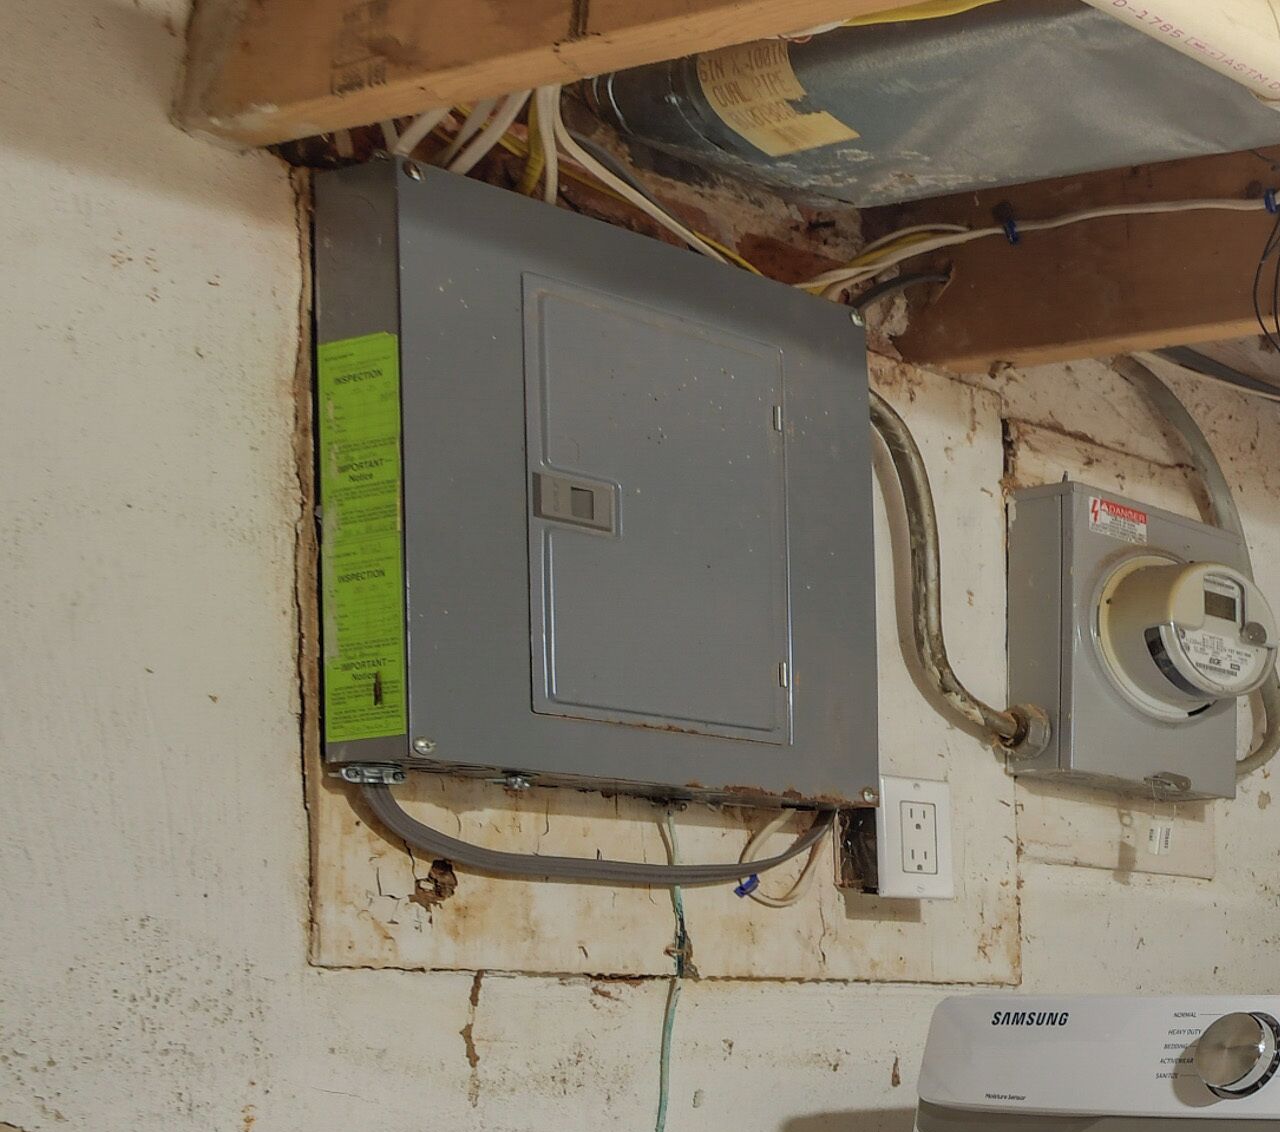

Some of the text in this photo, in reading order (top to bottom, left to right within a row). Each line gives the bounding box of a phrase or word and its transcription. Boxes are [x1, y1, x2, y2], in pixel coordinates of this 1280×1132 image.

[334, 368, 383, 385] INSPECTION
[1109, 503, 1147, 524] DANGER
[337, 567, 386, 583] INSPECTION
[991, 1011, 1069, 1026] SAMSUNG
